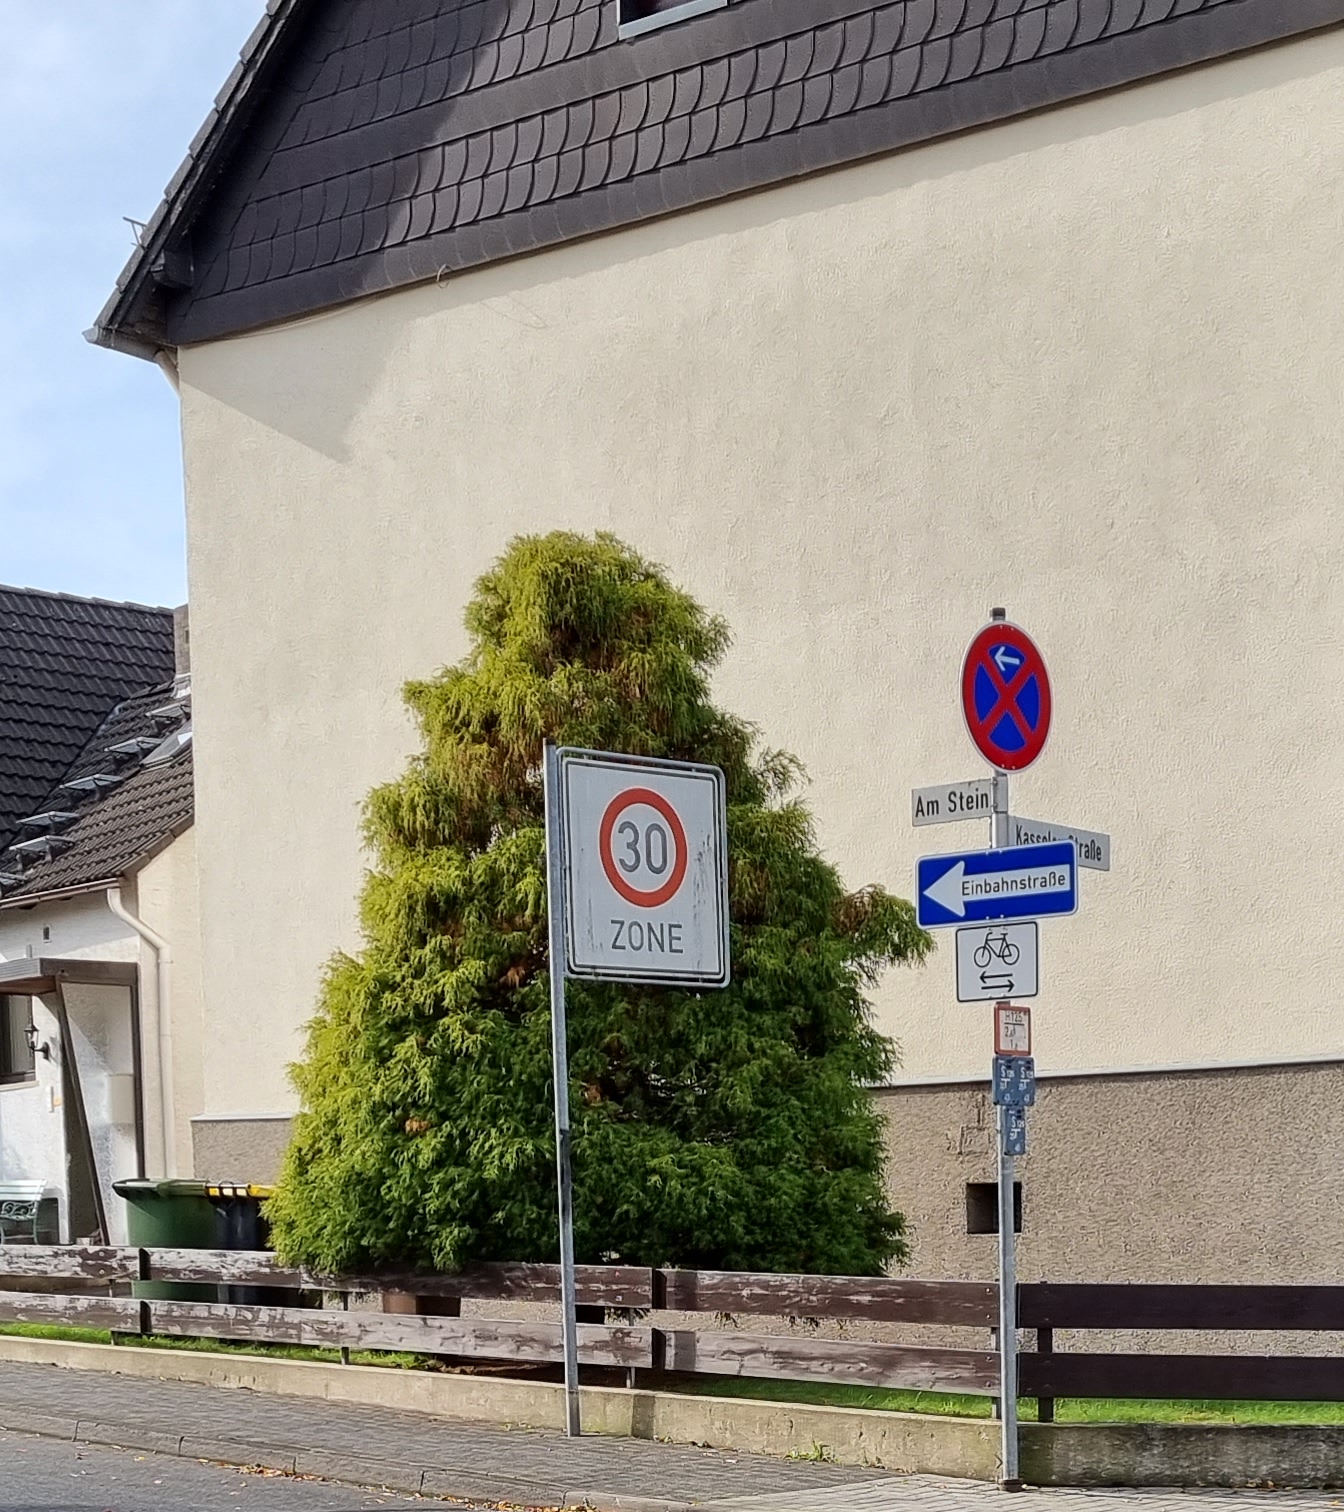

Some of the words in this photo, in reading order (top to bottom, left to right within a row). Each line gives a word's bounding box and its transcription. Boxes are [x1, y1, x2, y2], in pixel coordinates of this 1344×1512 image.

[915, 795, 939, 818] Am
[948, 787, 989, 812] Stein
[617, 820, 668, 875] 30
[1016, 824, 1063, 847] Kassl
[1068, 834, 1102, 862] raße
[961, 871, 1066, 896] Einbahnstraße
[610, 919, 684, 954] ZONE
